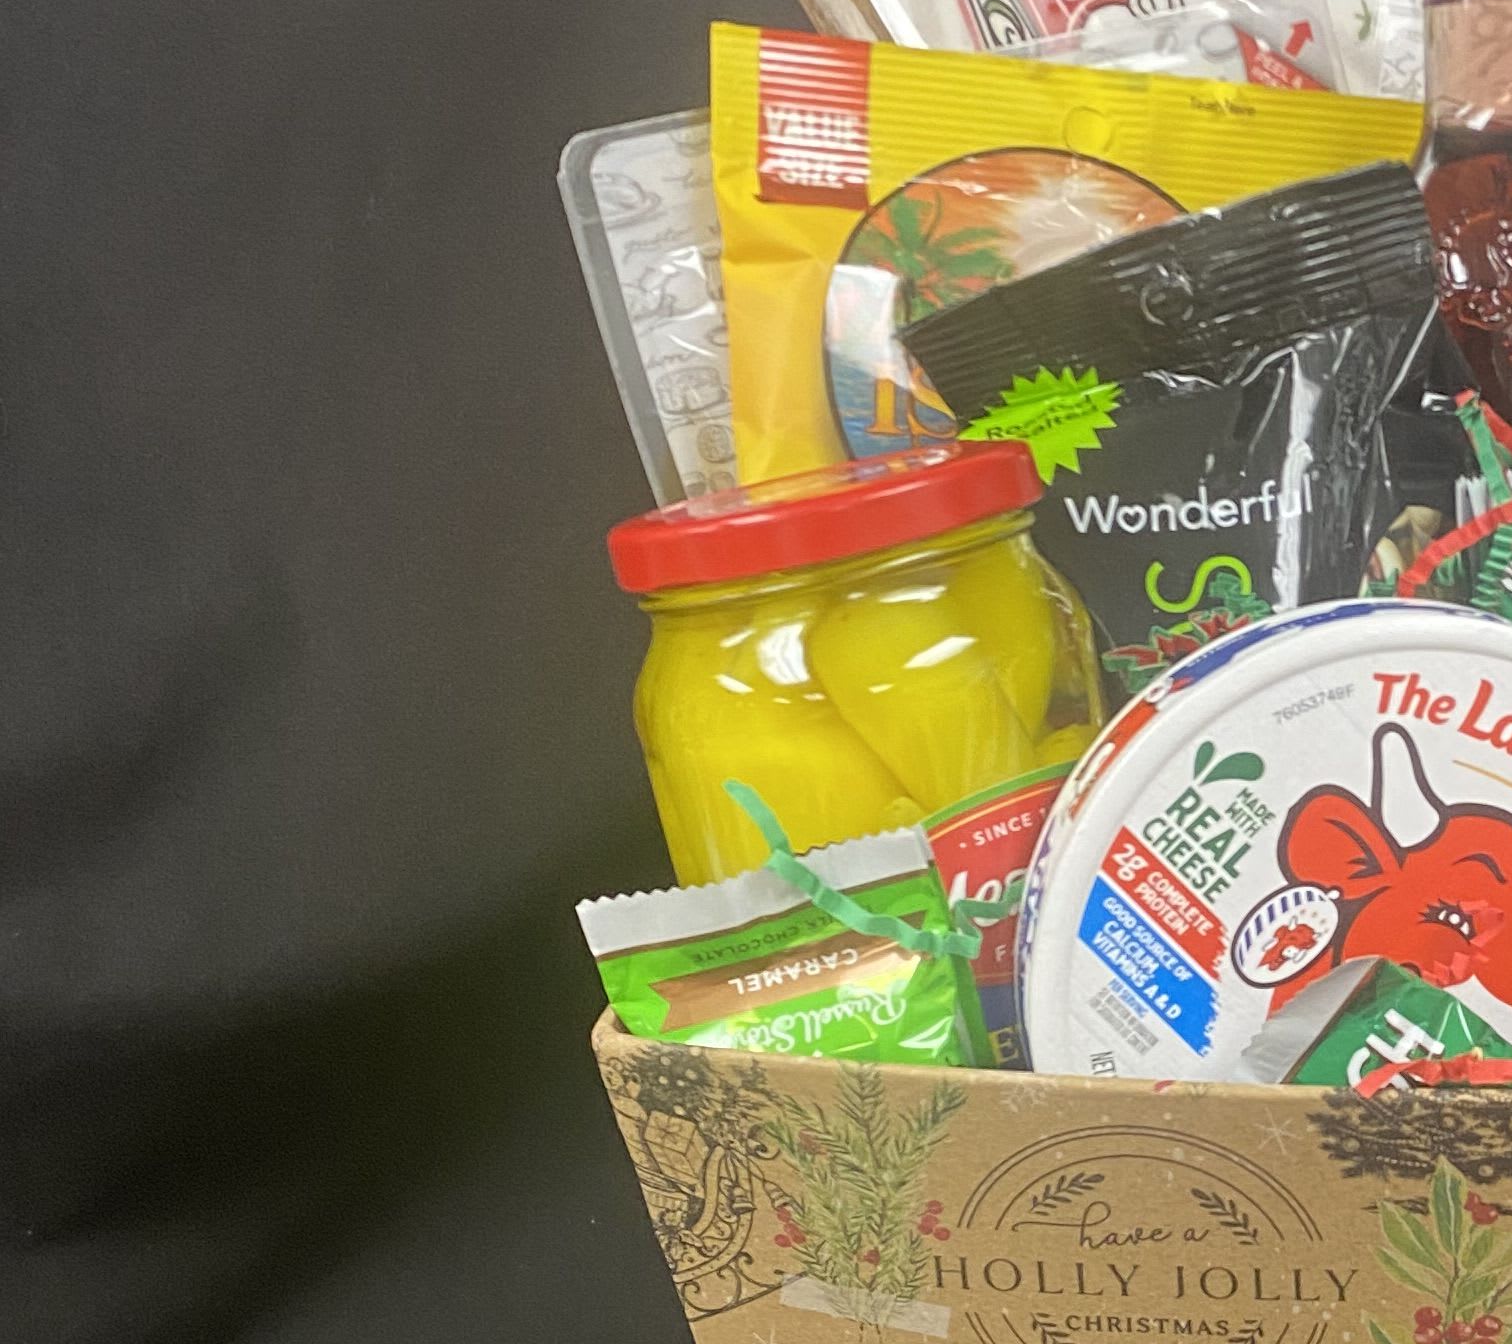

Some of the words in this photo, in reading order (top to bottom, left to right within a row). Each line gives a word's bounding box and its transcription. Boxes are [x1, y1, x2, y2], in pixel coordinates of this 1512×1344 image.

[1063, 473, 1314, 534] Wonderful
[1373, 672, 1456, 725] The
[972, 811, 1033, 847] SINCE
[1165, 785, 1252, 880] REAL
[1224, 802, 1262, 839] WITH
[1235, 787, 1277, 827] MADE
[1142, 817, 1232, 905] CHEESE
[1133, 880, 1190, 937] PROTEIN
[1147, 871, 1215, 937] COMPLETE
[691, 924, 800, 966] CHOCOLATE
[1102, 896, 1137, 929] GOOD
[1132, 925, 1179, 973] SOURCE
[1173, 965, 1194, 983] OF
[728, 948, 859, 997] CARAMEL
[1091, 930, 1150, 988] VITAMINS
[1144, 984, 1159, 1000] A
[1155, 994, 1171, 1011] &
[1165, 1004, 1183, 1020] D
[797, 982, 908, 1044] Russell
[1012, 1201, 1174, 1250] have
[933, 1255, 1140, 1298] HOLLY
[1175, 1265, 1360, 1303] JOLLY
[1065, 1314, 1230, 1337] CHRISTMAS
